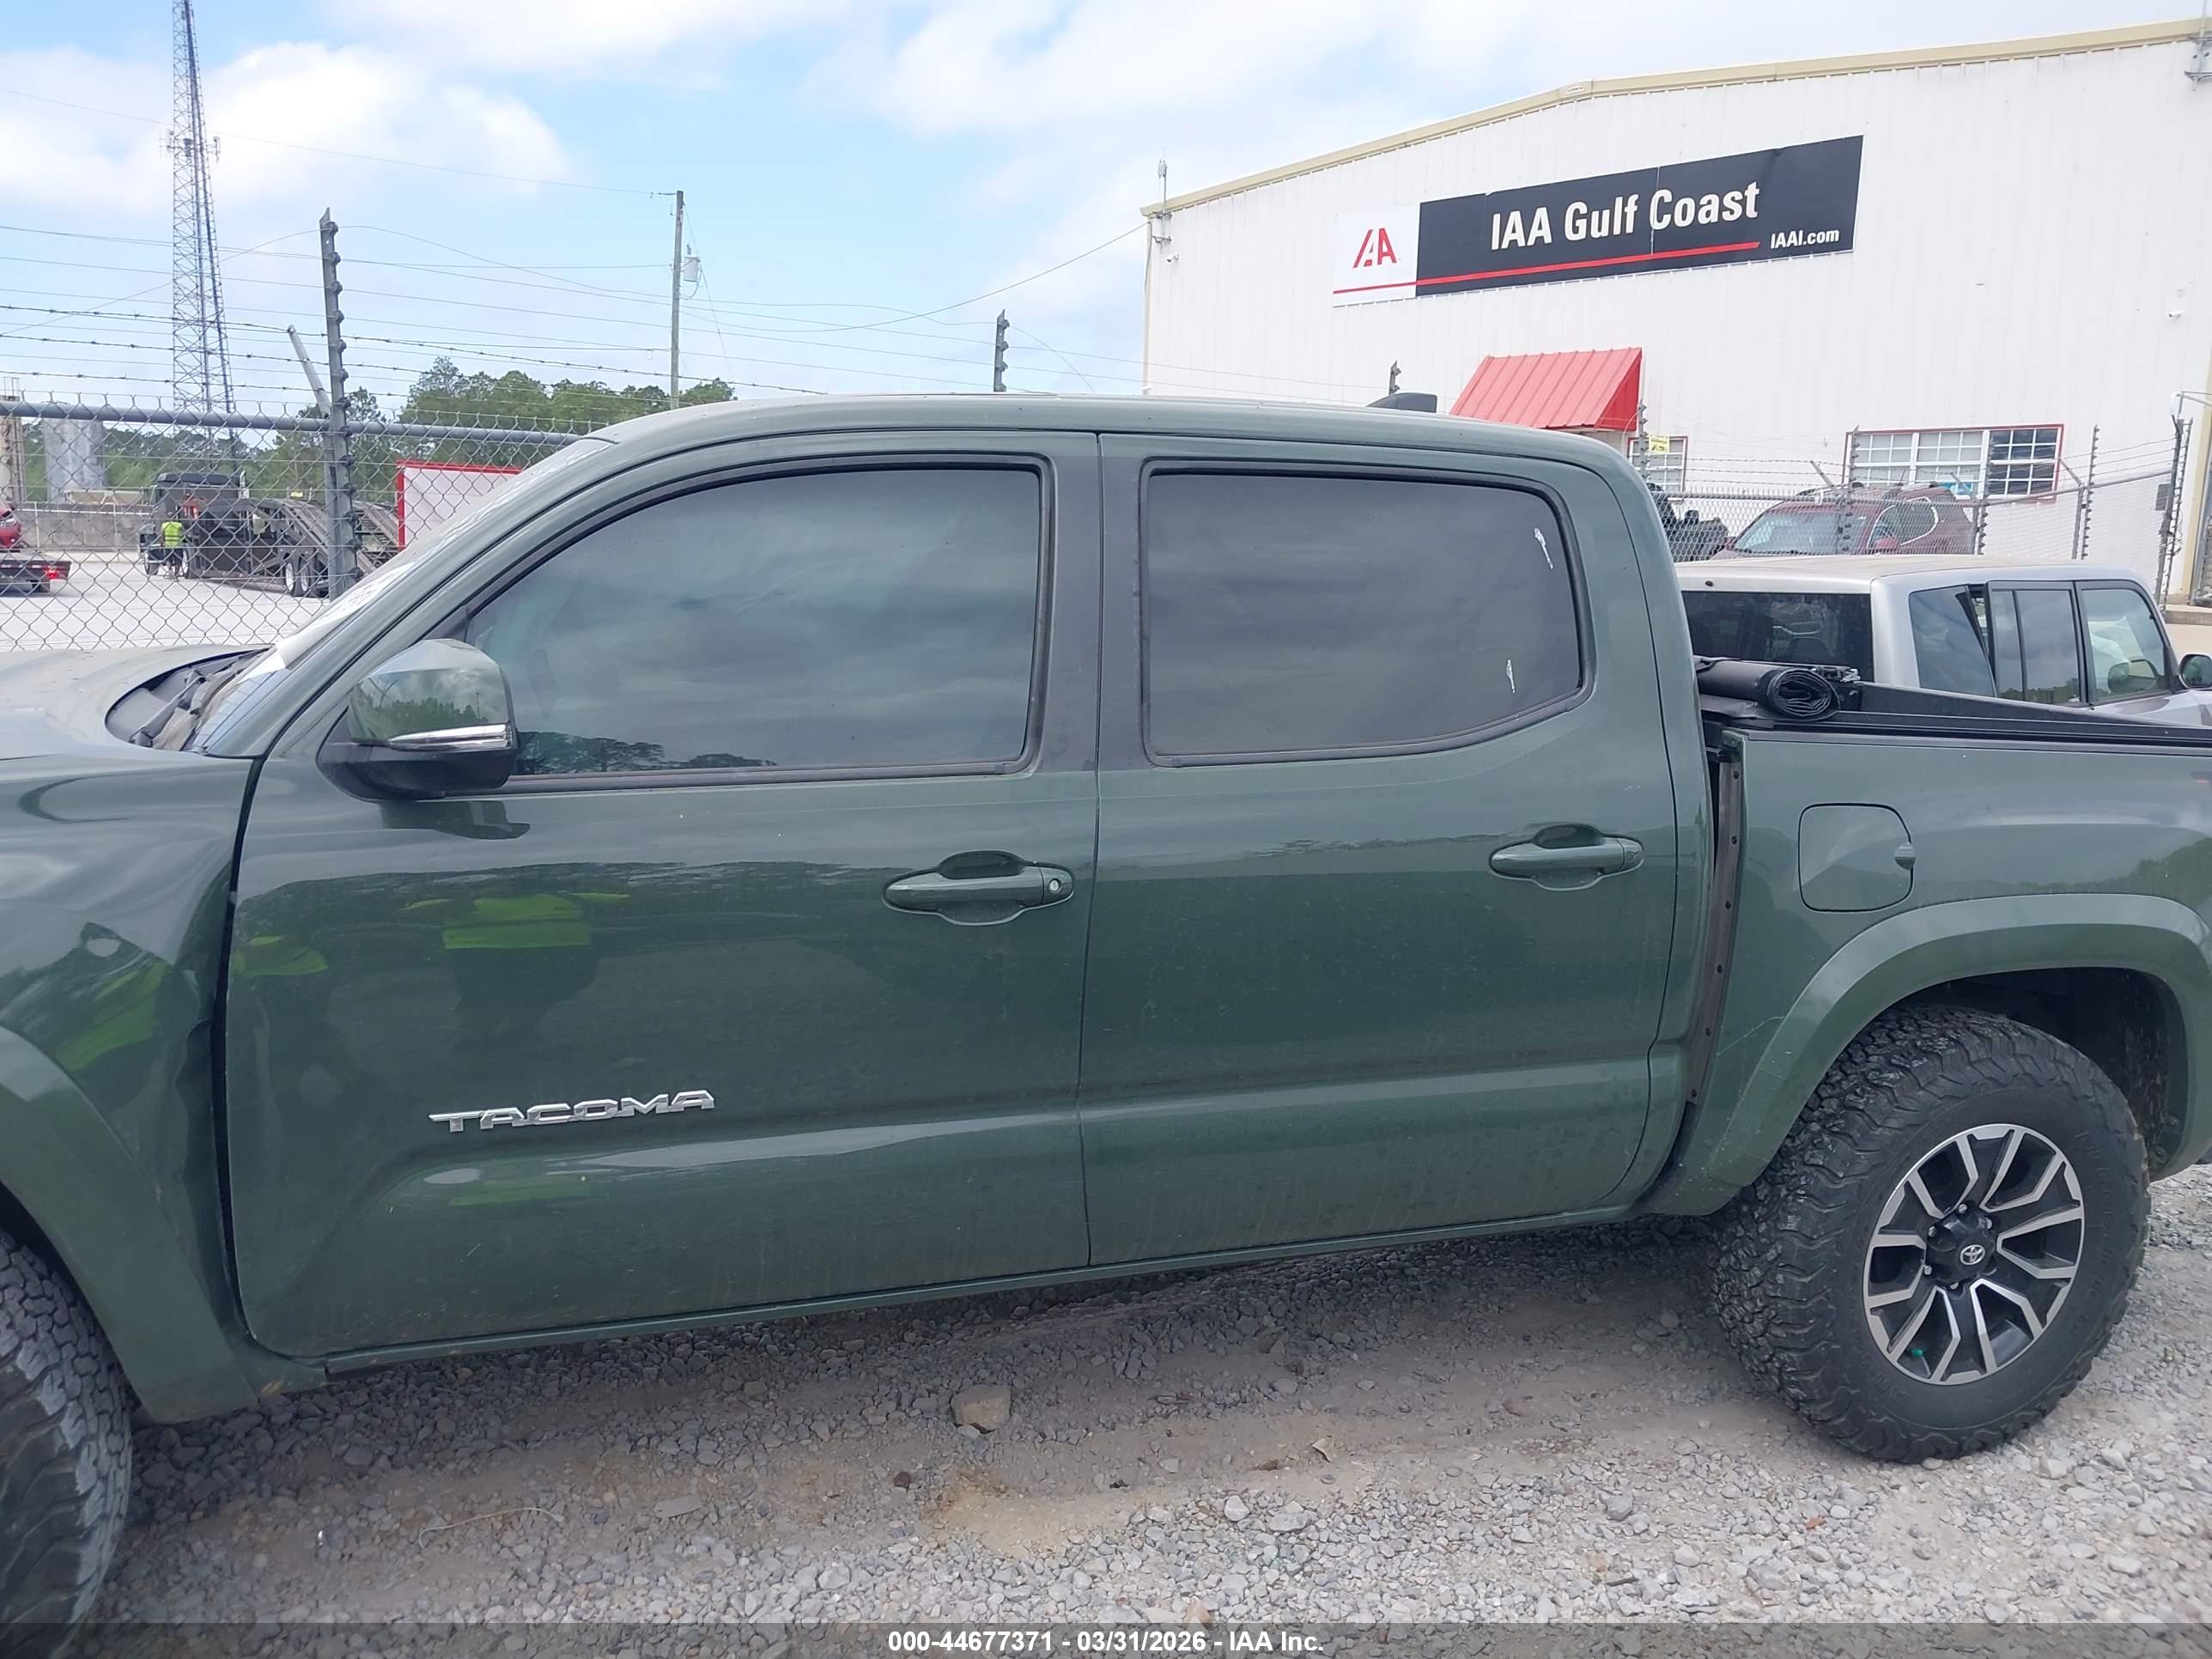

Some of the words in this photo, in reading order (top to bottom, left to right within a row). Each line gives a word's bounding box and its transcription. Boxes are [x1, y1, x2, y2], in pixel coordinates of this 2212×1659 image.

[1491, 206, 1553, 250] IAA
[1565, 193, 1639, 241] Gulf
[1649, 181, 1760, 231] Coast
[1770, 228, 1840, 249] IAAI.com
[428, 1090, 715, 1133] TACOMA
